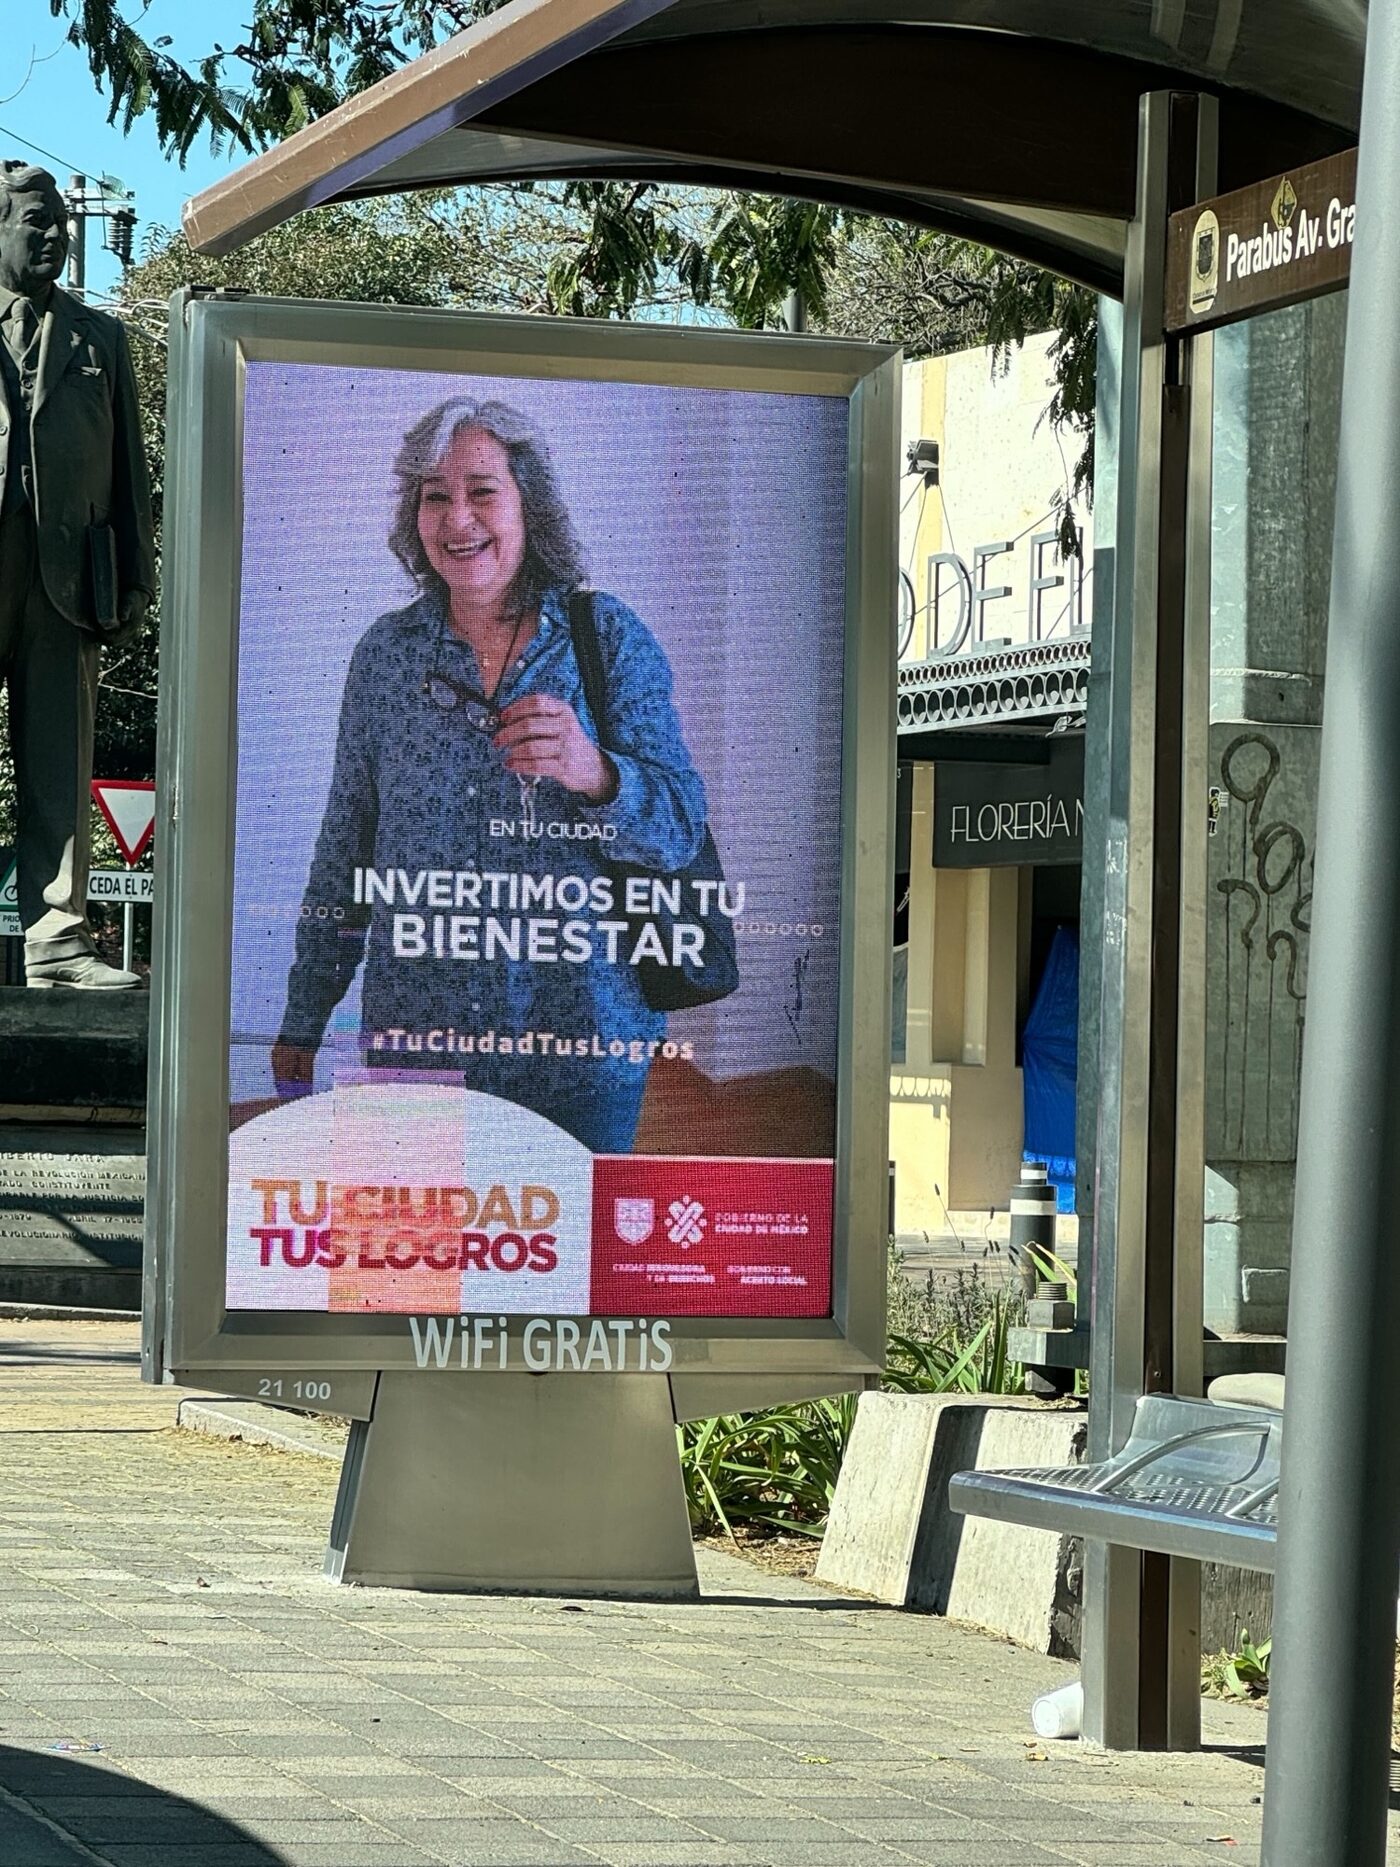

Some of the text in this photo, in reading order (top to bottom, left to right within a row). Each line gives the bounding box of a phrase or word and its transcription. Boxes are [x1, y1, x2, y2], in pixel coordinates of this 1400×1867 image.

[1226, 222, 1292, 282] Parabus
[1295, 208, 1323, 260] Av.
[489, 820, 618, 840] EN TU CIUDAD
[951, 794, 1070, 842] FLORERÍA
[89, 876, 121, 895] CEDA
[125, 878, 138, 896] EL
[353, 867, 745, 918] INVERTIMOS EN TU
[392, 914, 705, 967] BIENESTAR
[372, 1029, 694, 1062] #TuCiudadTusLogros
[250, 1178, 560, 1231] TU CIUDAD
[250, 1228, 559, 1272] TUS LOGROS
[408, 1316, 672, 1371] WiFi GRATiS
[258, 1378, 331, 1399] 21 100
